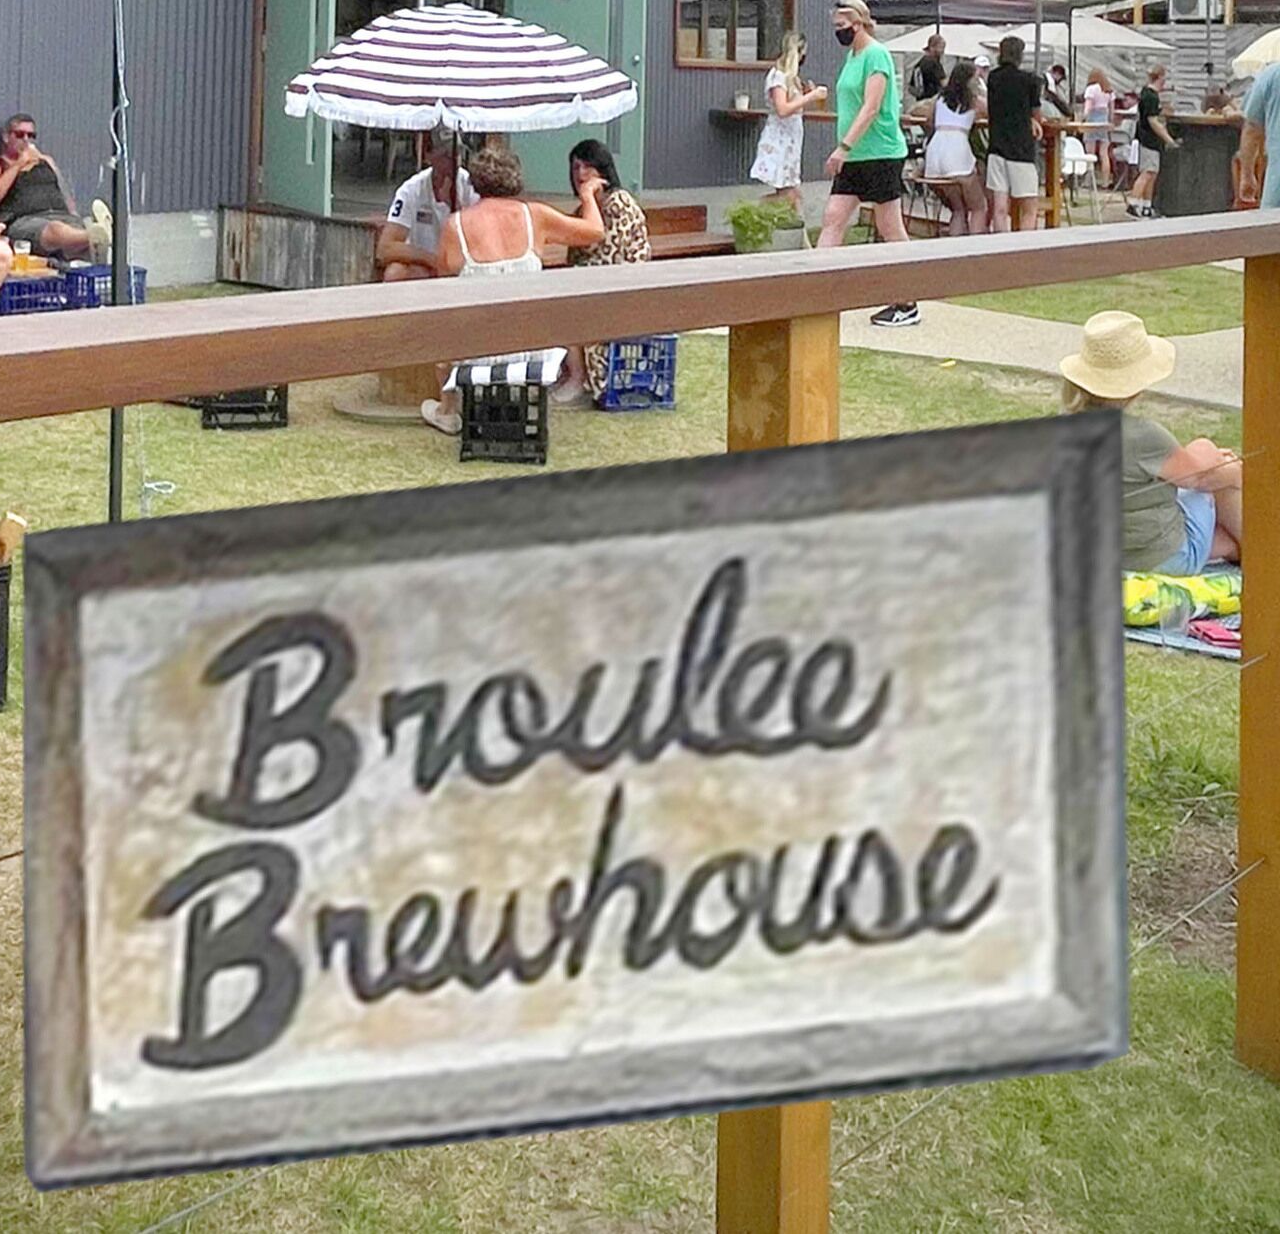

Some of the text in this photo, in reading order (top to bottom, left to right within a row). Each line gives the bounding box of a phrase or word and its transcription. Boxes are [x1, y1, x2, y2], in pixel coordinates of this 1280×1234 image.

[391, 199, 403, 218] 3
[192, 556, 893, 831] Broulee
[140, 785, 998, 1073] Brewhouse
